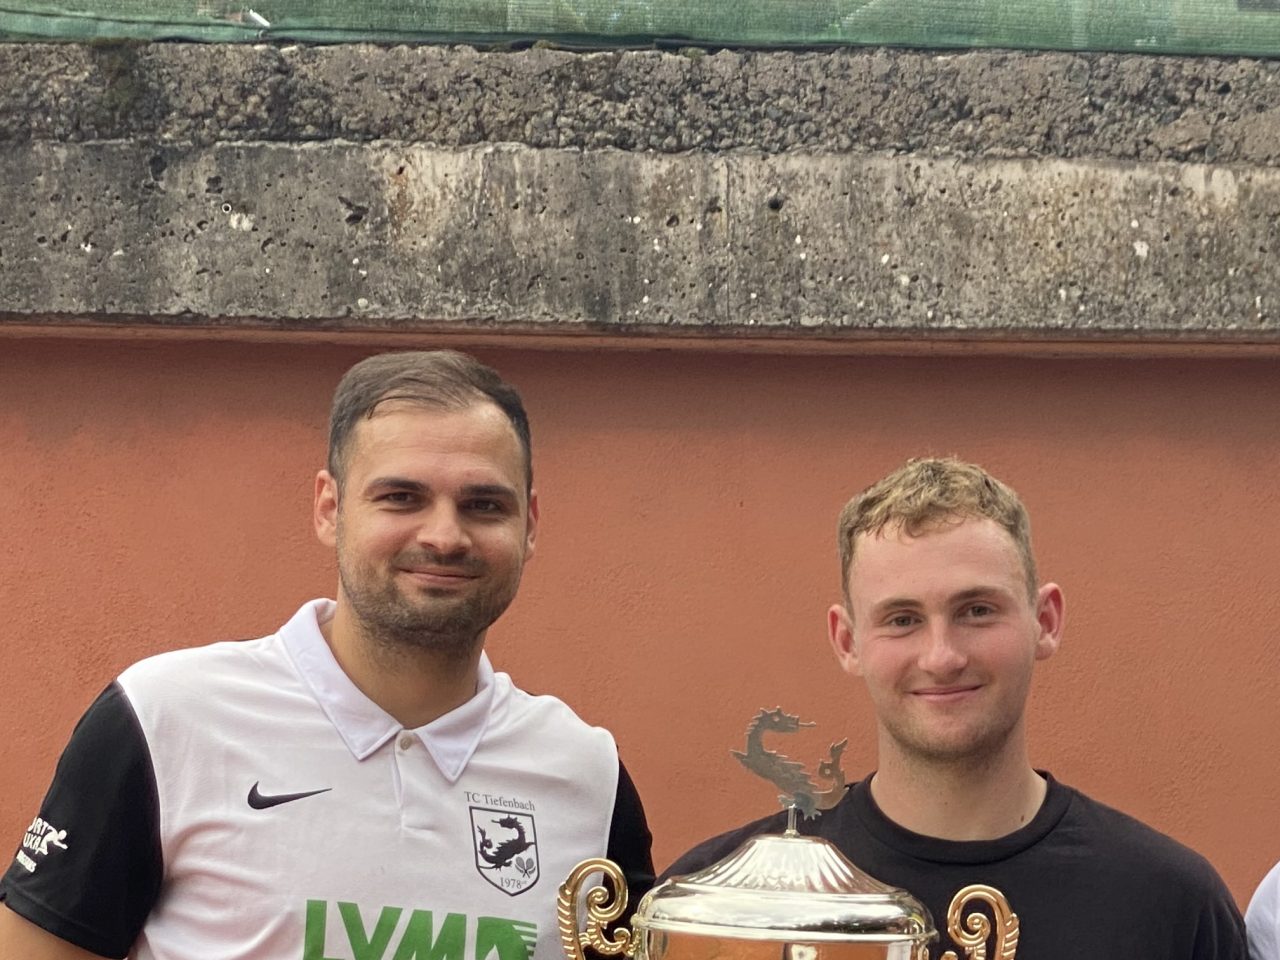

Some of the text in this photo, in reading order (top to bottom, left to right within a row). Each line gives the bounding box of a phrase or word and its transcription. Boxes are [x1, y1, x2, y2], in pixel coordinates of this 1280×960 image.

[464, 791, 536, 811] TC Tiefenbach
[500, 877, 522, 889] 1978
